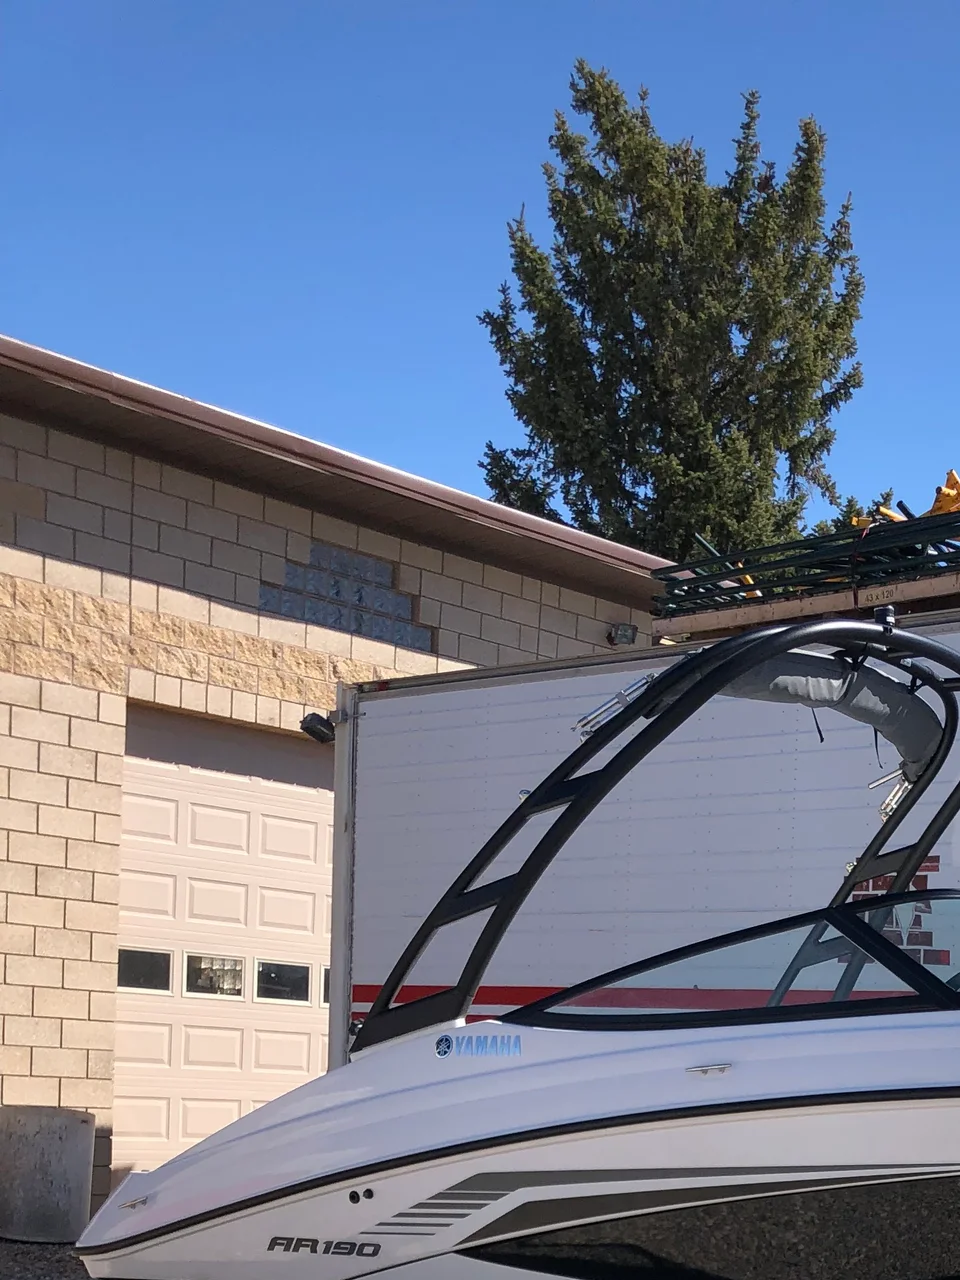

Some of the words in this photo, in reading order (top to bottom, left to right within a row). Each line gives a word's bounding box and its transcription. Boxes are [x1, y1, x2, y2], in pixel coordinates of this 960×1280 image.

[882, 589, 894, 600] 120
[455, 1034, 522, 1058] YAMAHA
[266, 1236, 382, 1258] AR190
